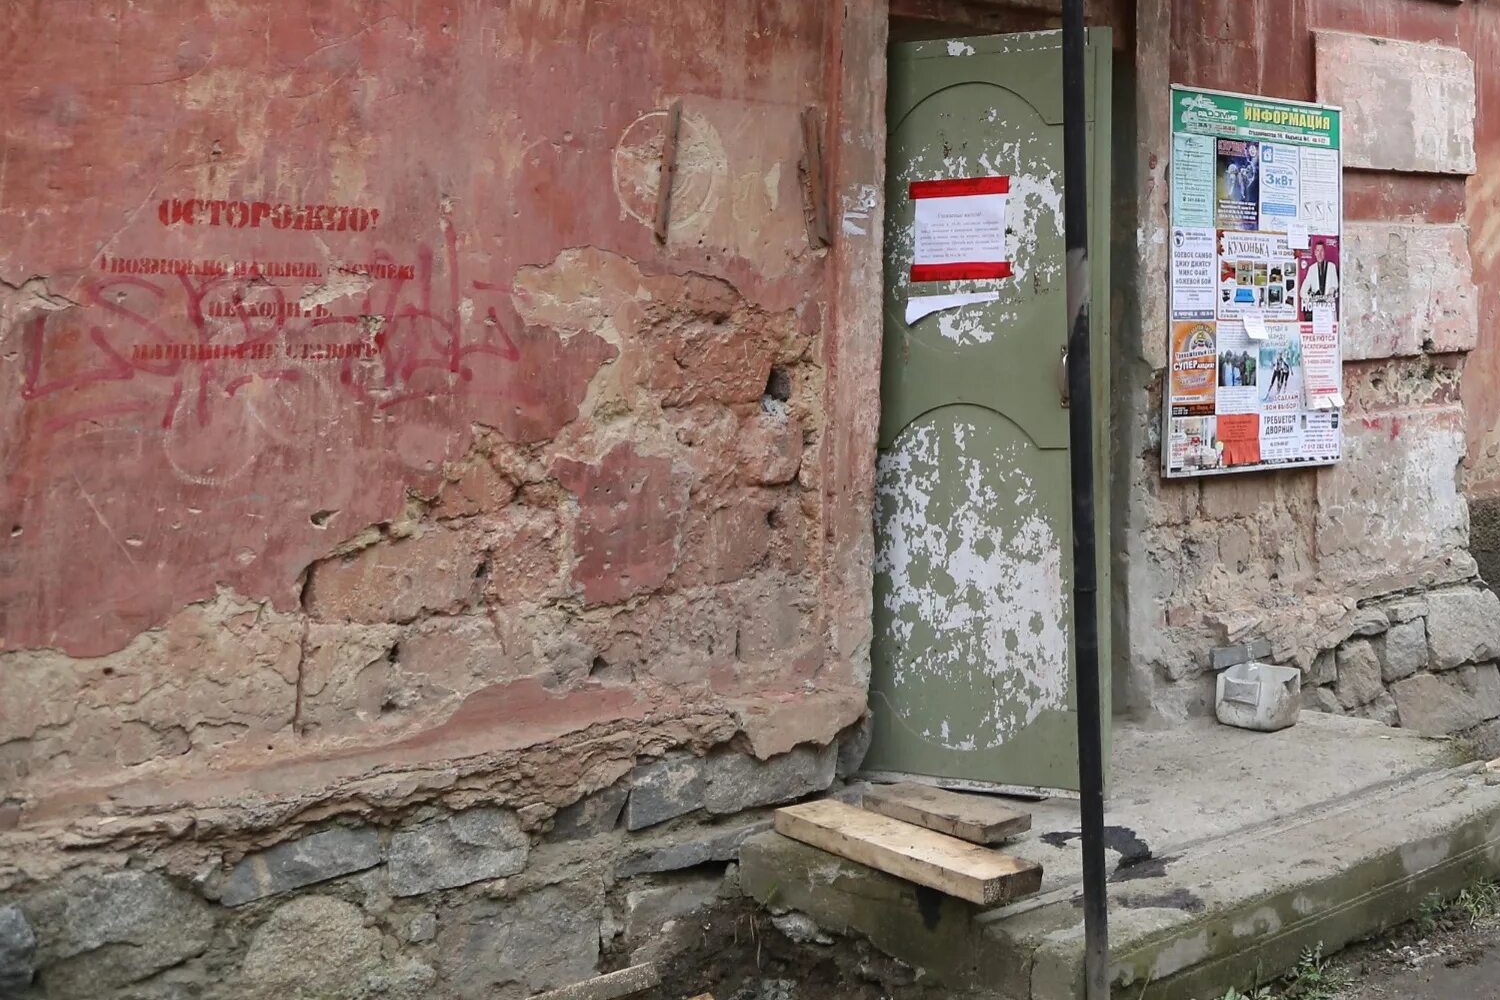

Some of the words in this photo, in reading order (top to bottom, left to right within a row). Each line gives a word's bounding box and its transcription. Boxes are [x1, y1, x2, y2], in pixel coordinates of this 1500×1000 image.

[1244, 106, 1330, 130] ИНФОРМАЦИЯ
[158, 198, 380, 232] ОСТОРОЖНО!
[1228, 240, 1270, 258] КУХОНЬКА
[1263, 414, 1296, 425] ТРЕБУЕТСЯ
[1265, 425, 1294, 436] ДВОРНИК
